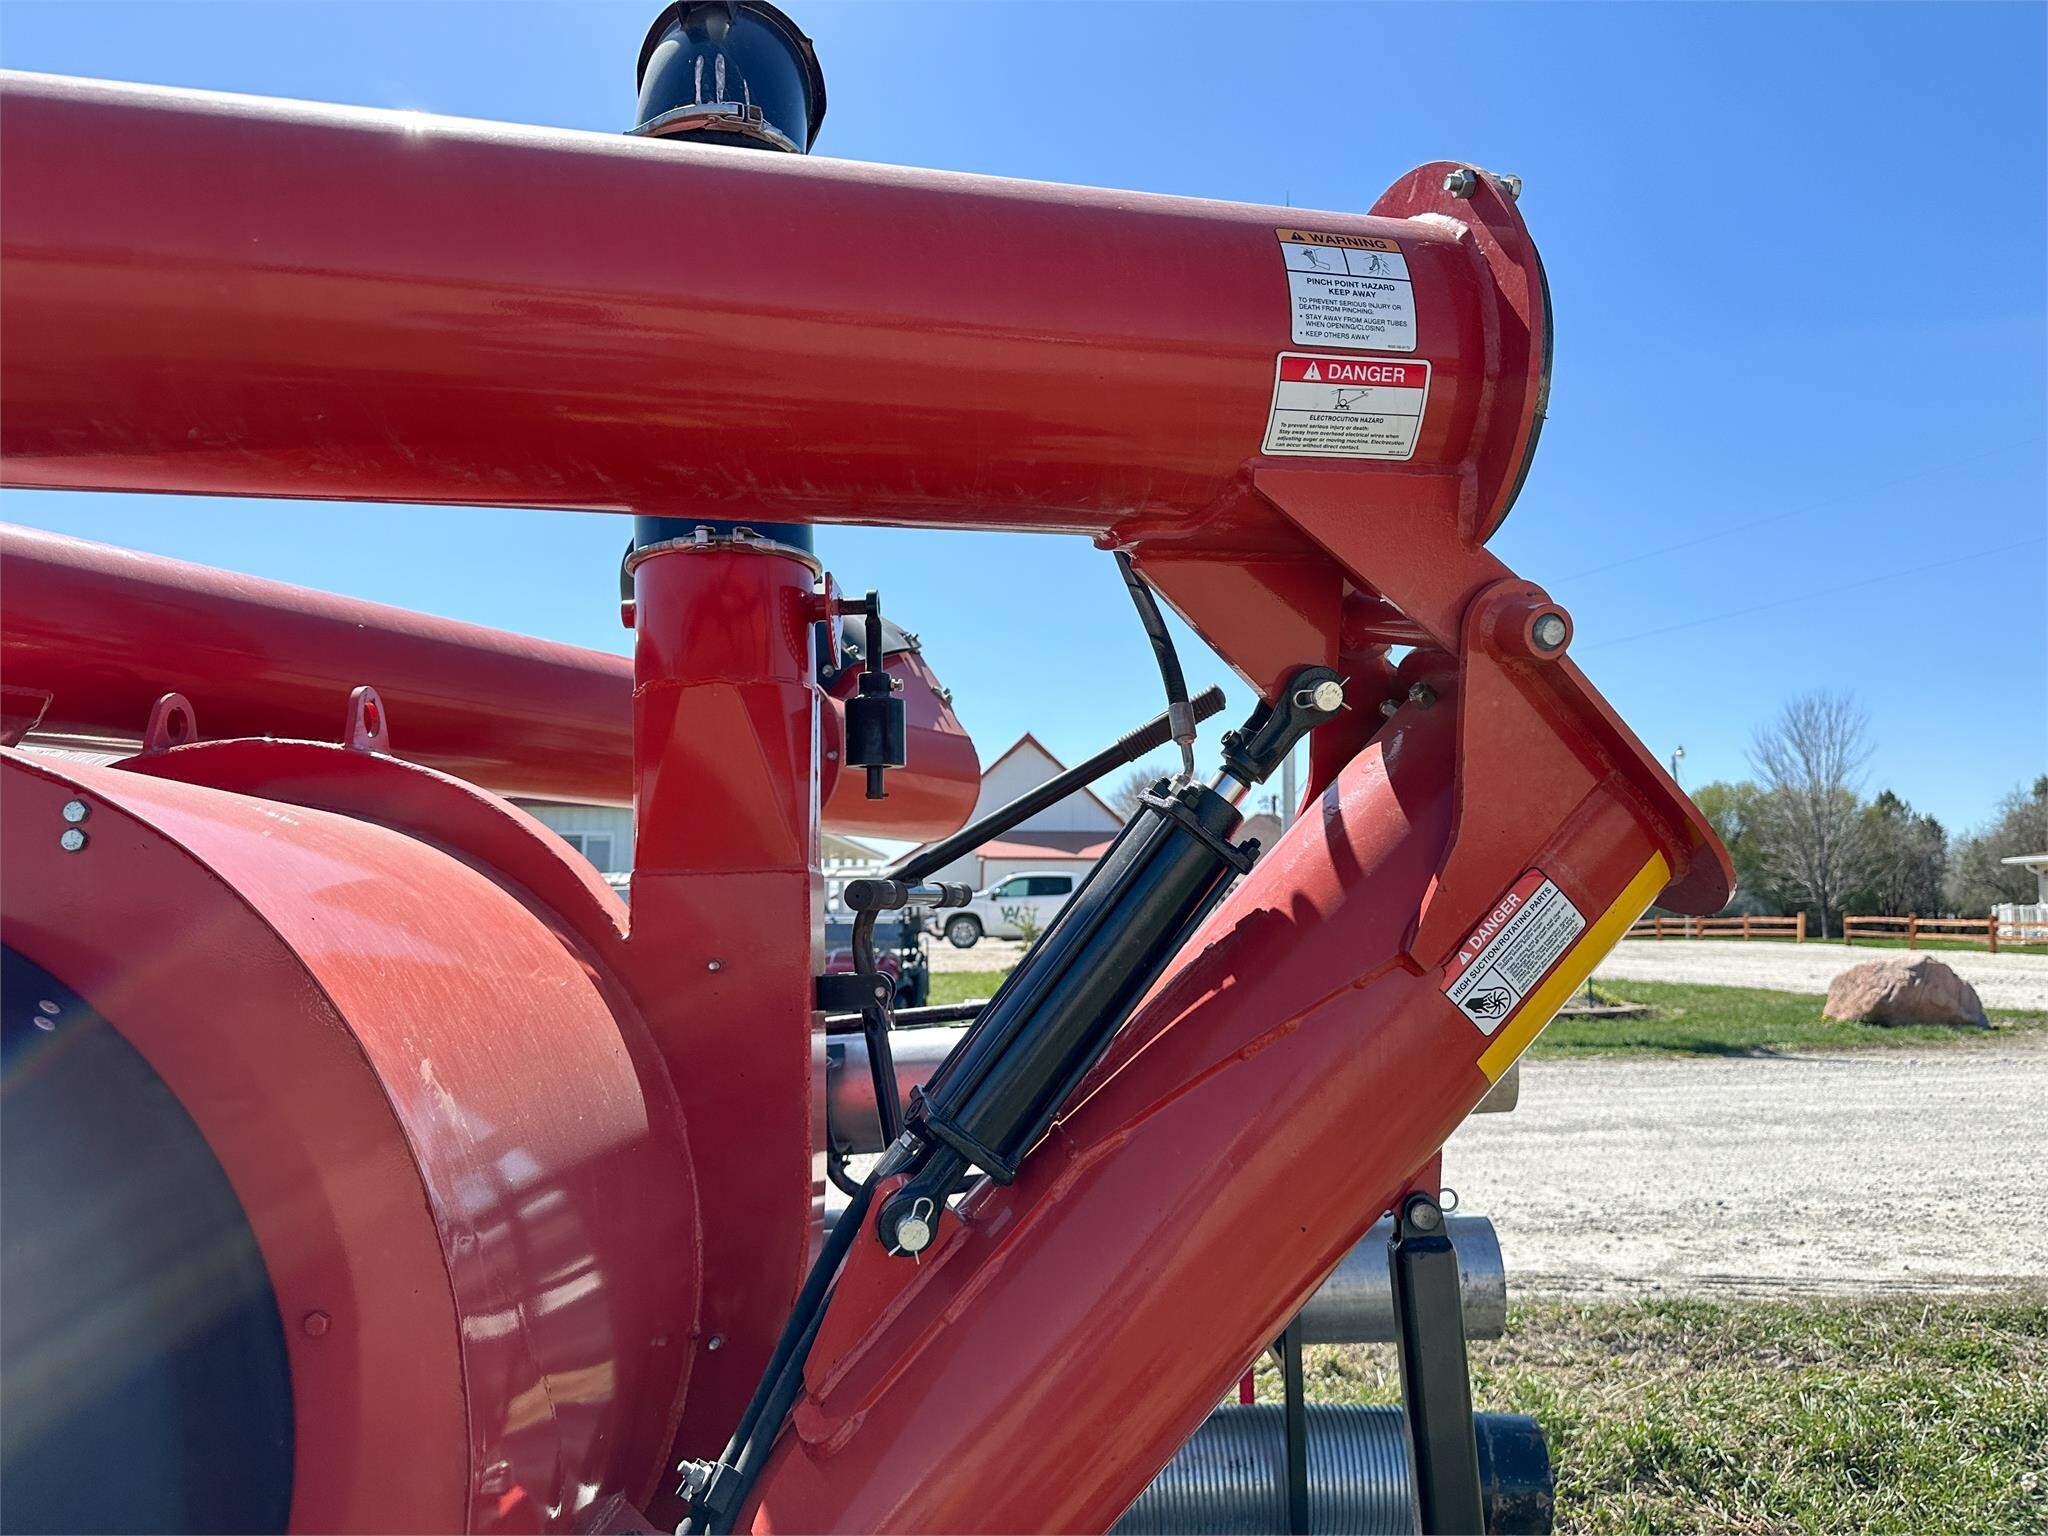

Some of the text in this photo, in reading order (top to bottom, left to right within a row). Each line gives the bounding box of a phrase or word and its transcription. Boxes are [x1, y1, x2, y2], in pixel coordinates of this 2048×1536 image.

[1309, 233, 1387, 249] WARNING
[1306, 278, 1395, 291] PINCH POINT HAZARD
[1328, 288, 1376, 298] KEEP AWAY
[1339, 300, 1367, 308] SERIOUS
[1342, 307, 1374, 315] PINCHING:
[1326, 322, 1385, 332] OPENING/CLOSING
[1324, 332, 1350, 340] OTHERS
[1328, 364, 1405, 383] DANGER
[1469, 893, 1521, 950] DANGER
[1453, 886, 1552, 998] HIGH SUCTION/ROTATING PARTS
